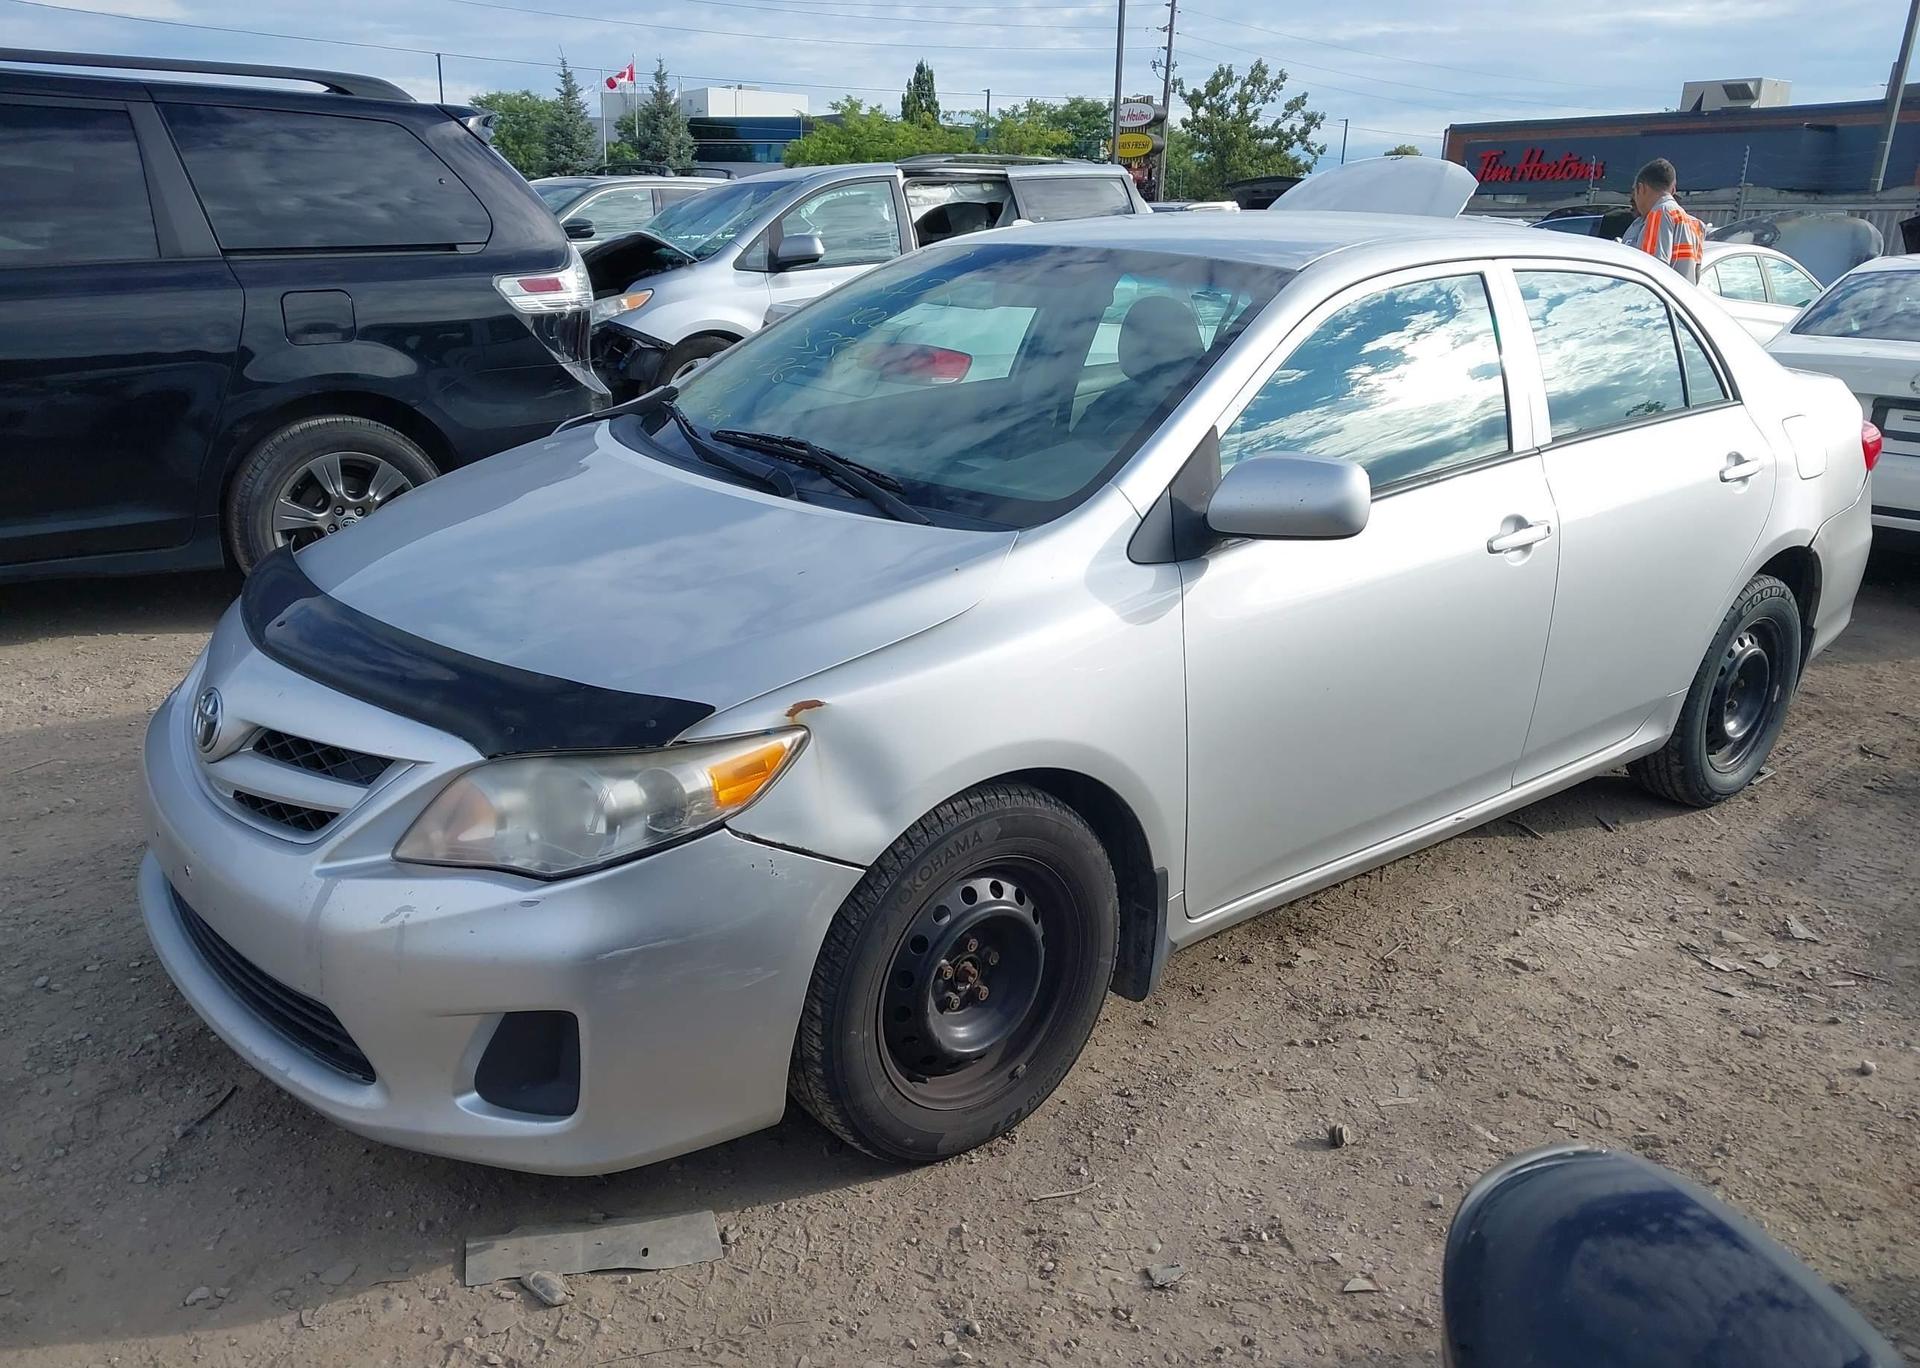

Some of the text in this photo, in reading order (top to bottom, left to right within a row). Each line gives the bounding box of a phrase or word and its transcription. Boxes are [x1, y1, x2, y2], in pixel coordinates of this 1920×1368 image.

[1126, 107, 1151, 121] Hortons
[1477, 147, 1605, 183] Tim Hortons
[889, 829, 984, 915] YOKOHAMA
